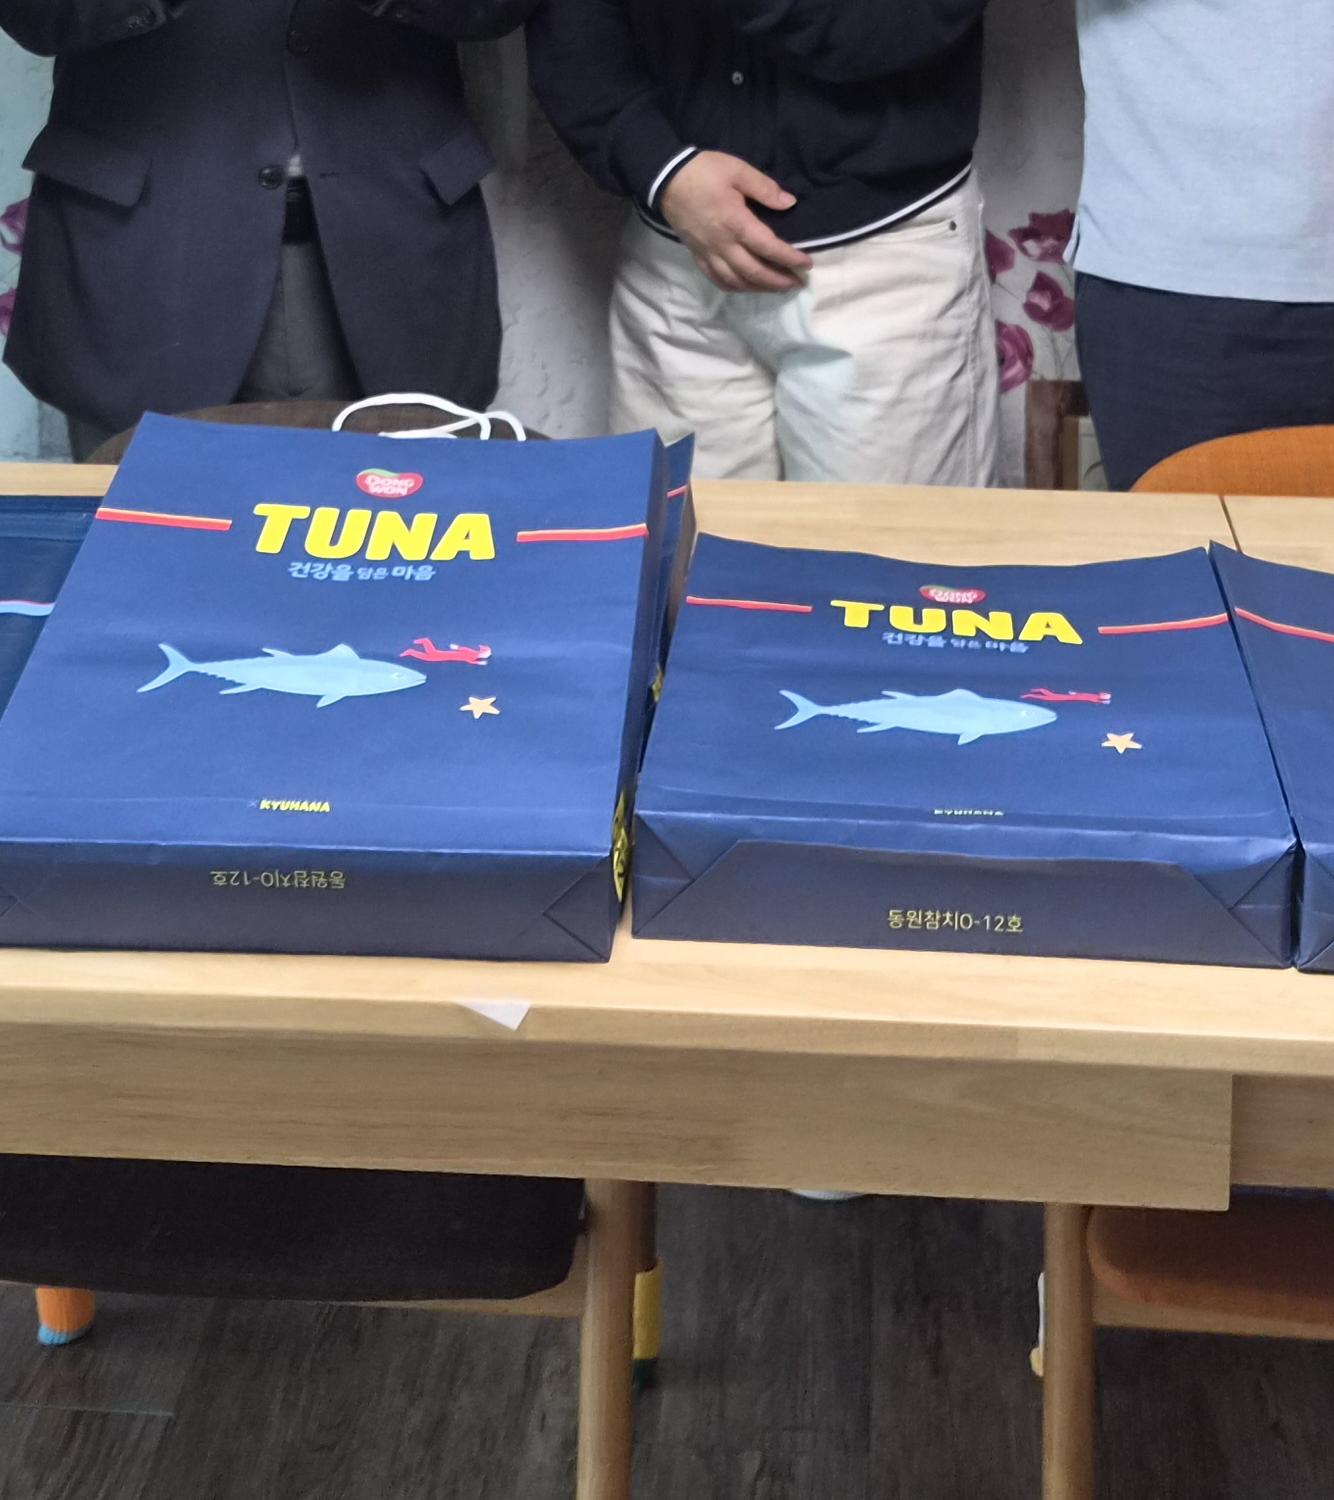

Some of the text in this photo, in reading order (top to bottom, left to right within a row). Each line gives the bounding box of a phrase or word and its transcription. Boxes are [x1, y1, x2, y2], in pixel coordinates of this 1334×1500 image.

[365, 475, 415, 488] DONG
[369, 485, 408, 496] WON
[253, 503, 496, 560] TUNA
[288, 562, 354, 581] 건강을
[391, 564, 436, 581] 마음
[830, 600, 1083, 645] TUNA
[259, 799, 331, 813] KYUHANA
